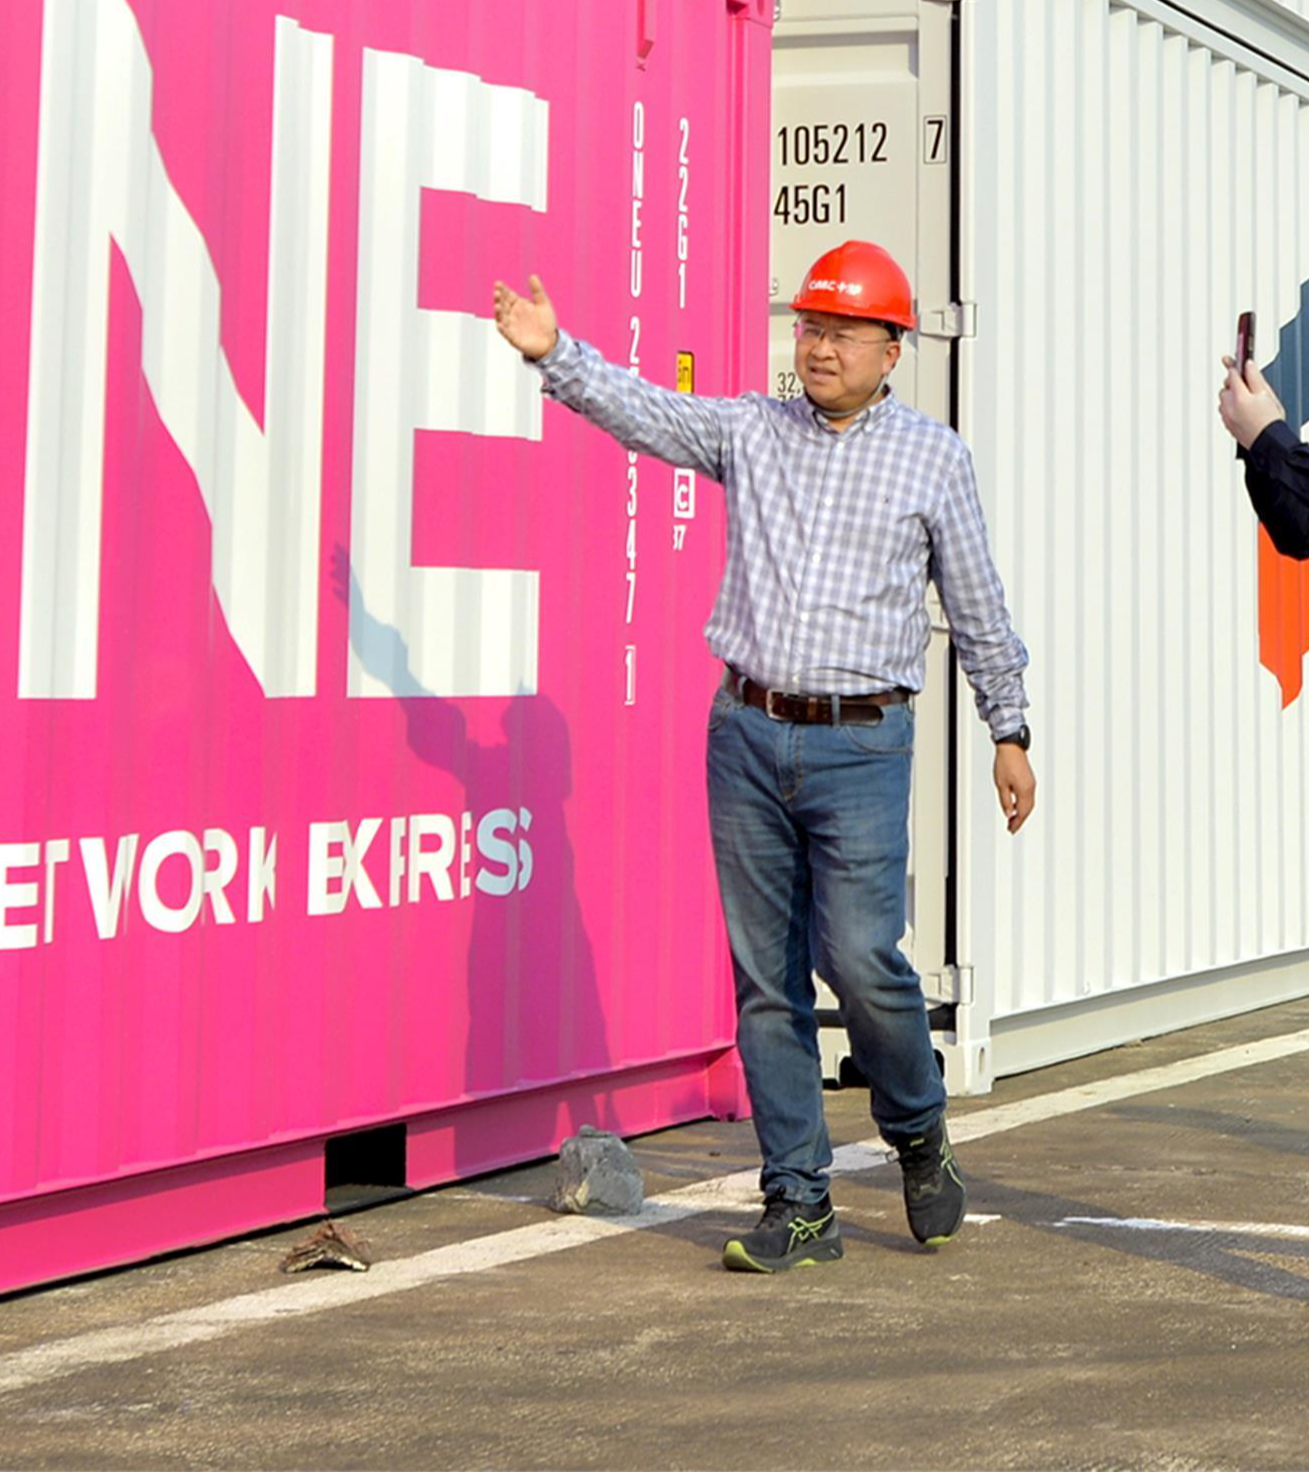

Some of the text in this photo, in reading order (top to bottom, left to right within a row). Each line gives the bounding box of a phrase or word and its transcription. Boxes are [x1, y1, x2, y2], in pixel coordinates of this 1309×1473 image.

[630, 101, 644, 298] ONEU
[778, 120, 944, 166] 105212 7
[678, 117, 689, 309] 22G1
[774, 184, 845, 225] 45G1
